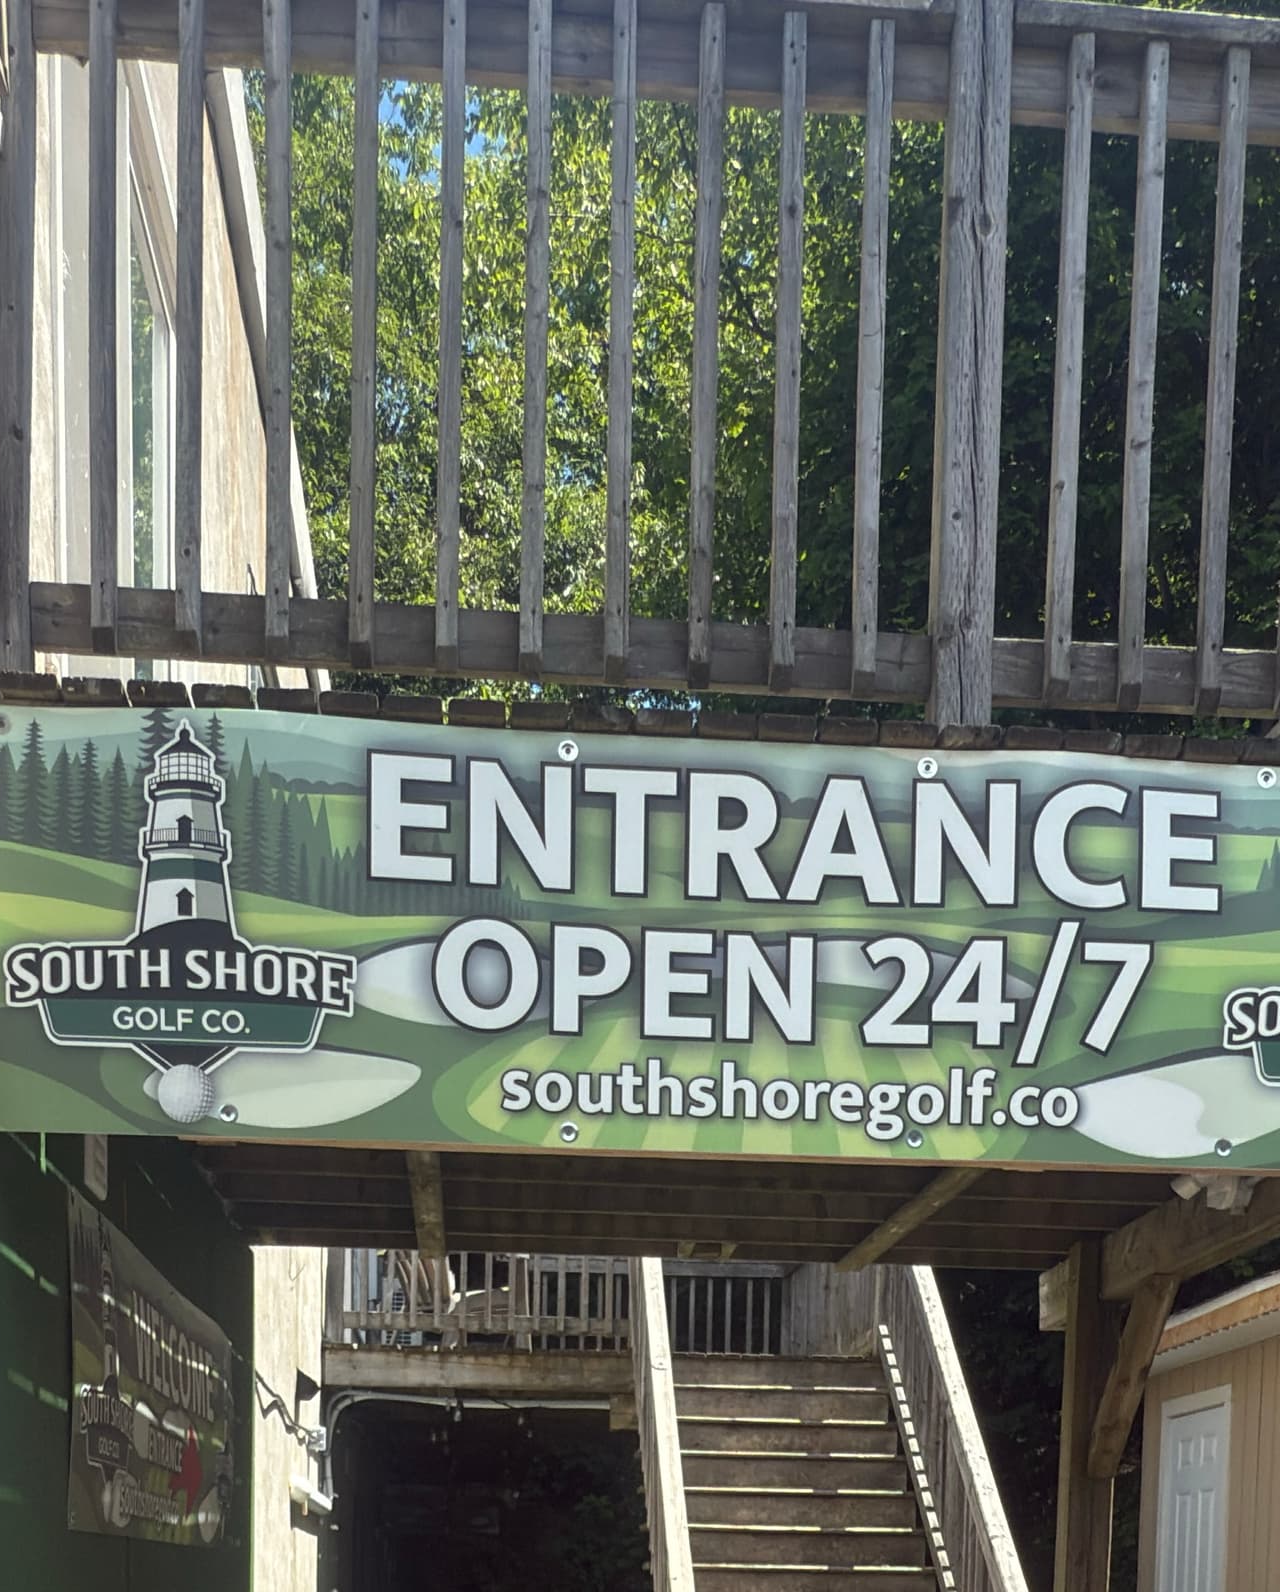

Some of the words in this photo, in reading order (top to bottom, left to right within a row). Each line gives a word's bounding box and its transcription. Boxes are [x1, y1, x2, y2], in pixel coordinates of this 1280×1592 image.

[367, 748, 1223, 914] ENTRANCE
[8, 946, 170, 999] SOUTH
[185, 948, 352, 1011] SHORE
[432, 914, 817, 1042] OPEN
[861, 919, 1154, 1068] 24/7
[111, 1005, 195, 1033] GOLF
[201, 1007, 252, 1035] CO.
[500, 1057, 1080, 1142] southshoregolf.co
[131, 1288, 216, 1422] WELCOME
[81, 1387, 110, 1427] SOUTH
[148, 1427, 183, 1473] ENTRANCE
